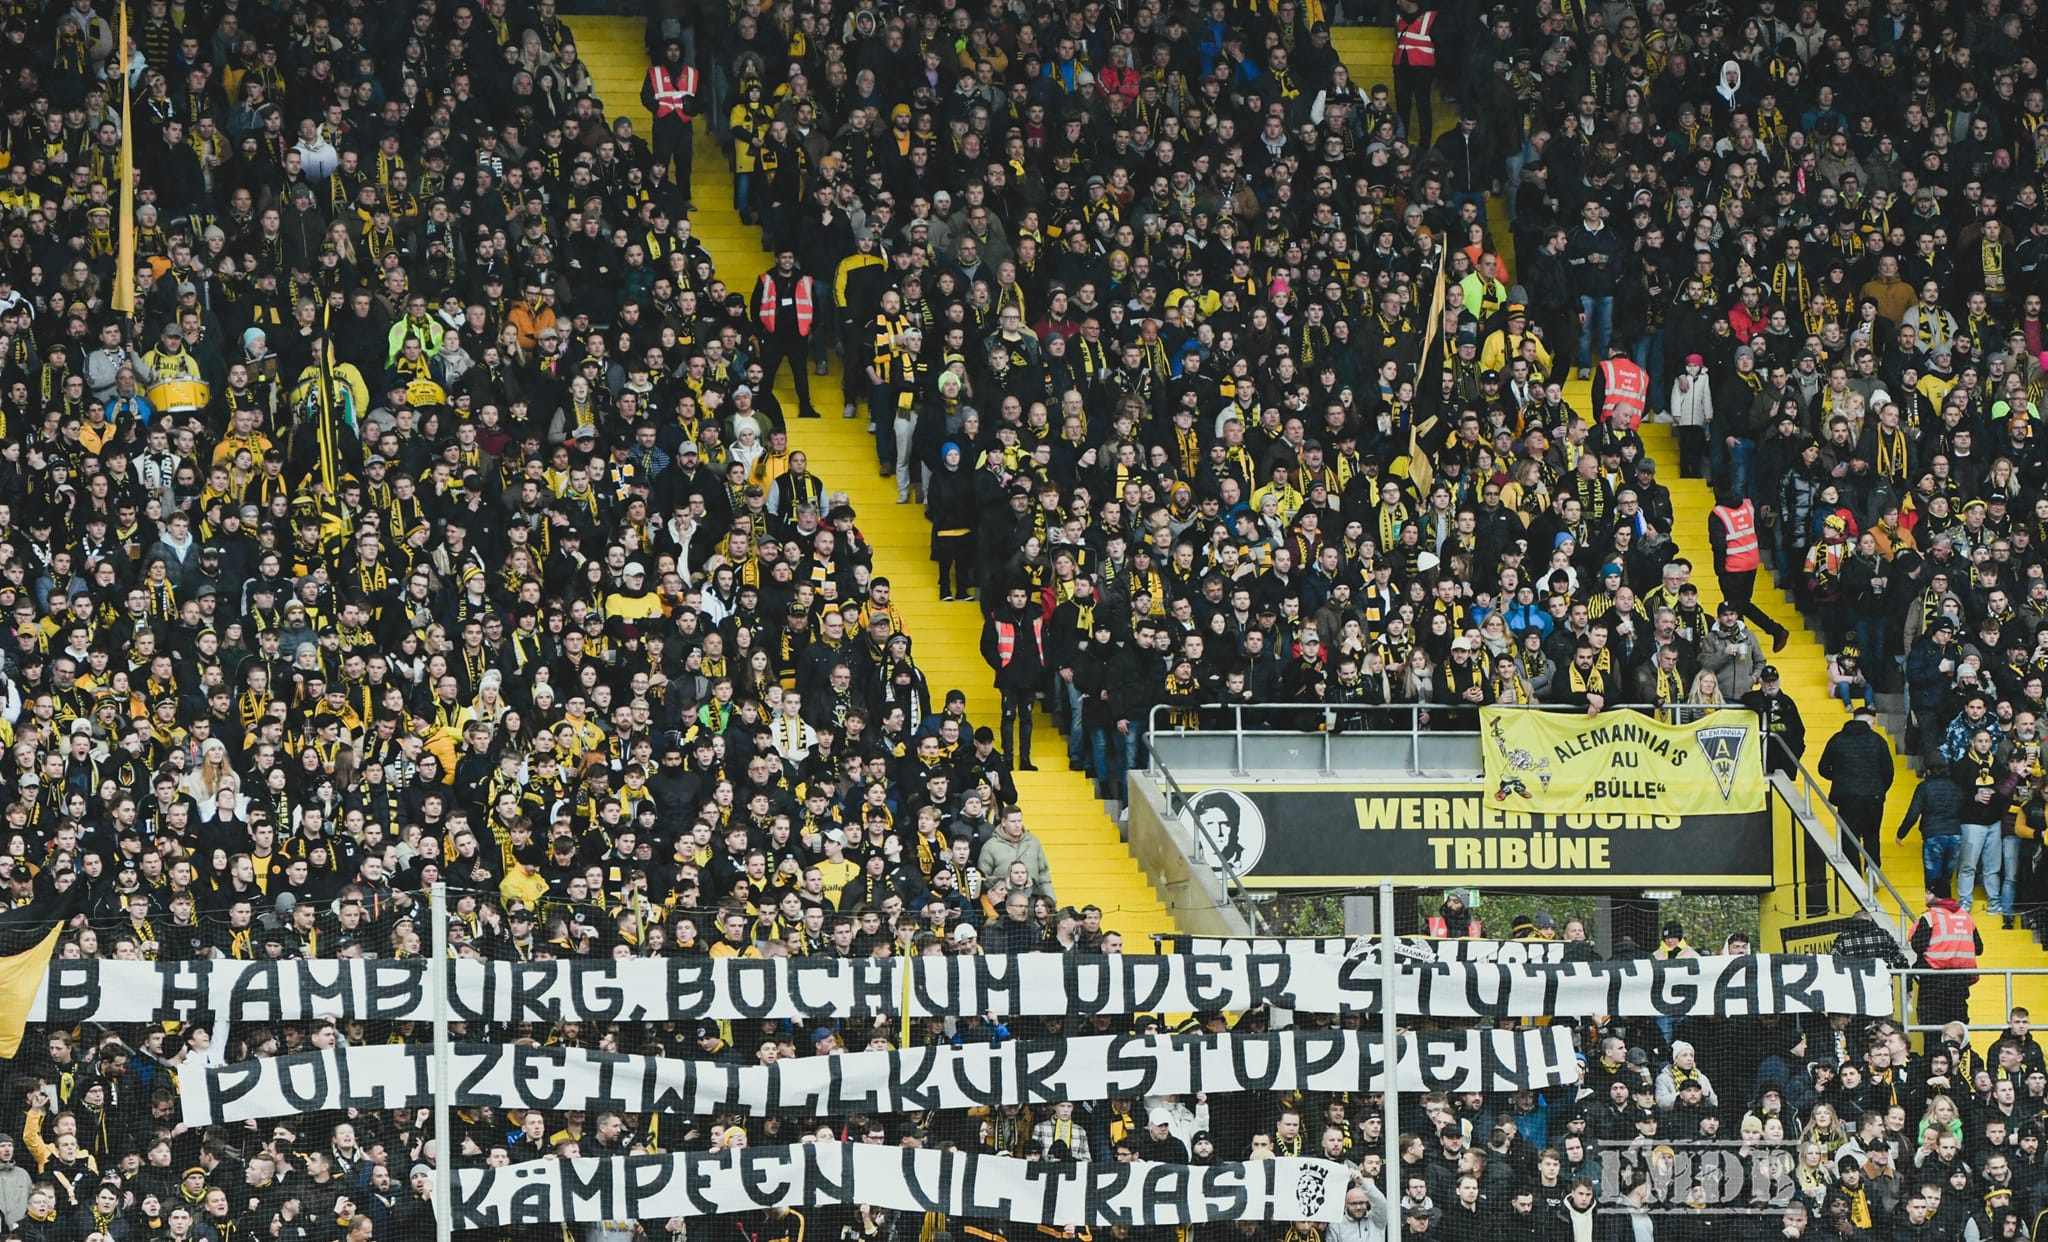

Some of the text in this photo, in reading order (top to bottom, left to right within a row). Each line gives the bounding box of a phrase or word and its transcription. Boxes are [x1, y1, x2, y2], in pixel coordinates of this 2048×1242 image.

[1554, 723, 1688, 768] ALEMANNIA'S
[1699, 730, 1742, 738] ALEMANNIA
[1611, 751, 1639, 768] AU
[1354, 797, 1532, 830] WERNER
[1428, 831, 1611, 870] TRIBÜNE
[153, 956, 647, 1022] HAMBURG,
[666, 952, 1022, 1019] BOCHUM
[1066, 952, 1297, 1017] ODER
[1337, 950, 1877, 1018] STUTTGART
[1106, 1029, 1561, 1098] STOPPEN!
[901, 1147, 1275, 1227] ULTRAS!
